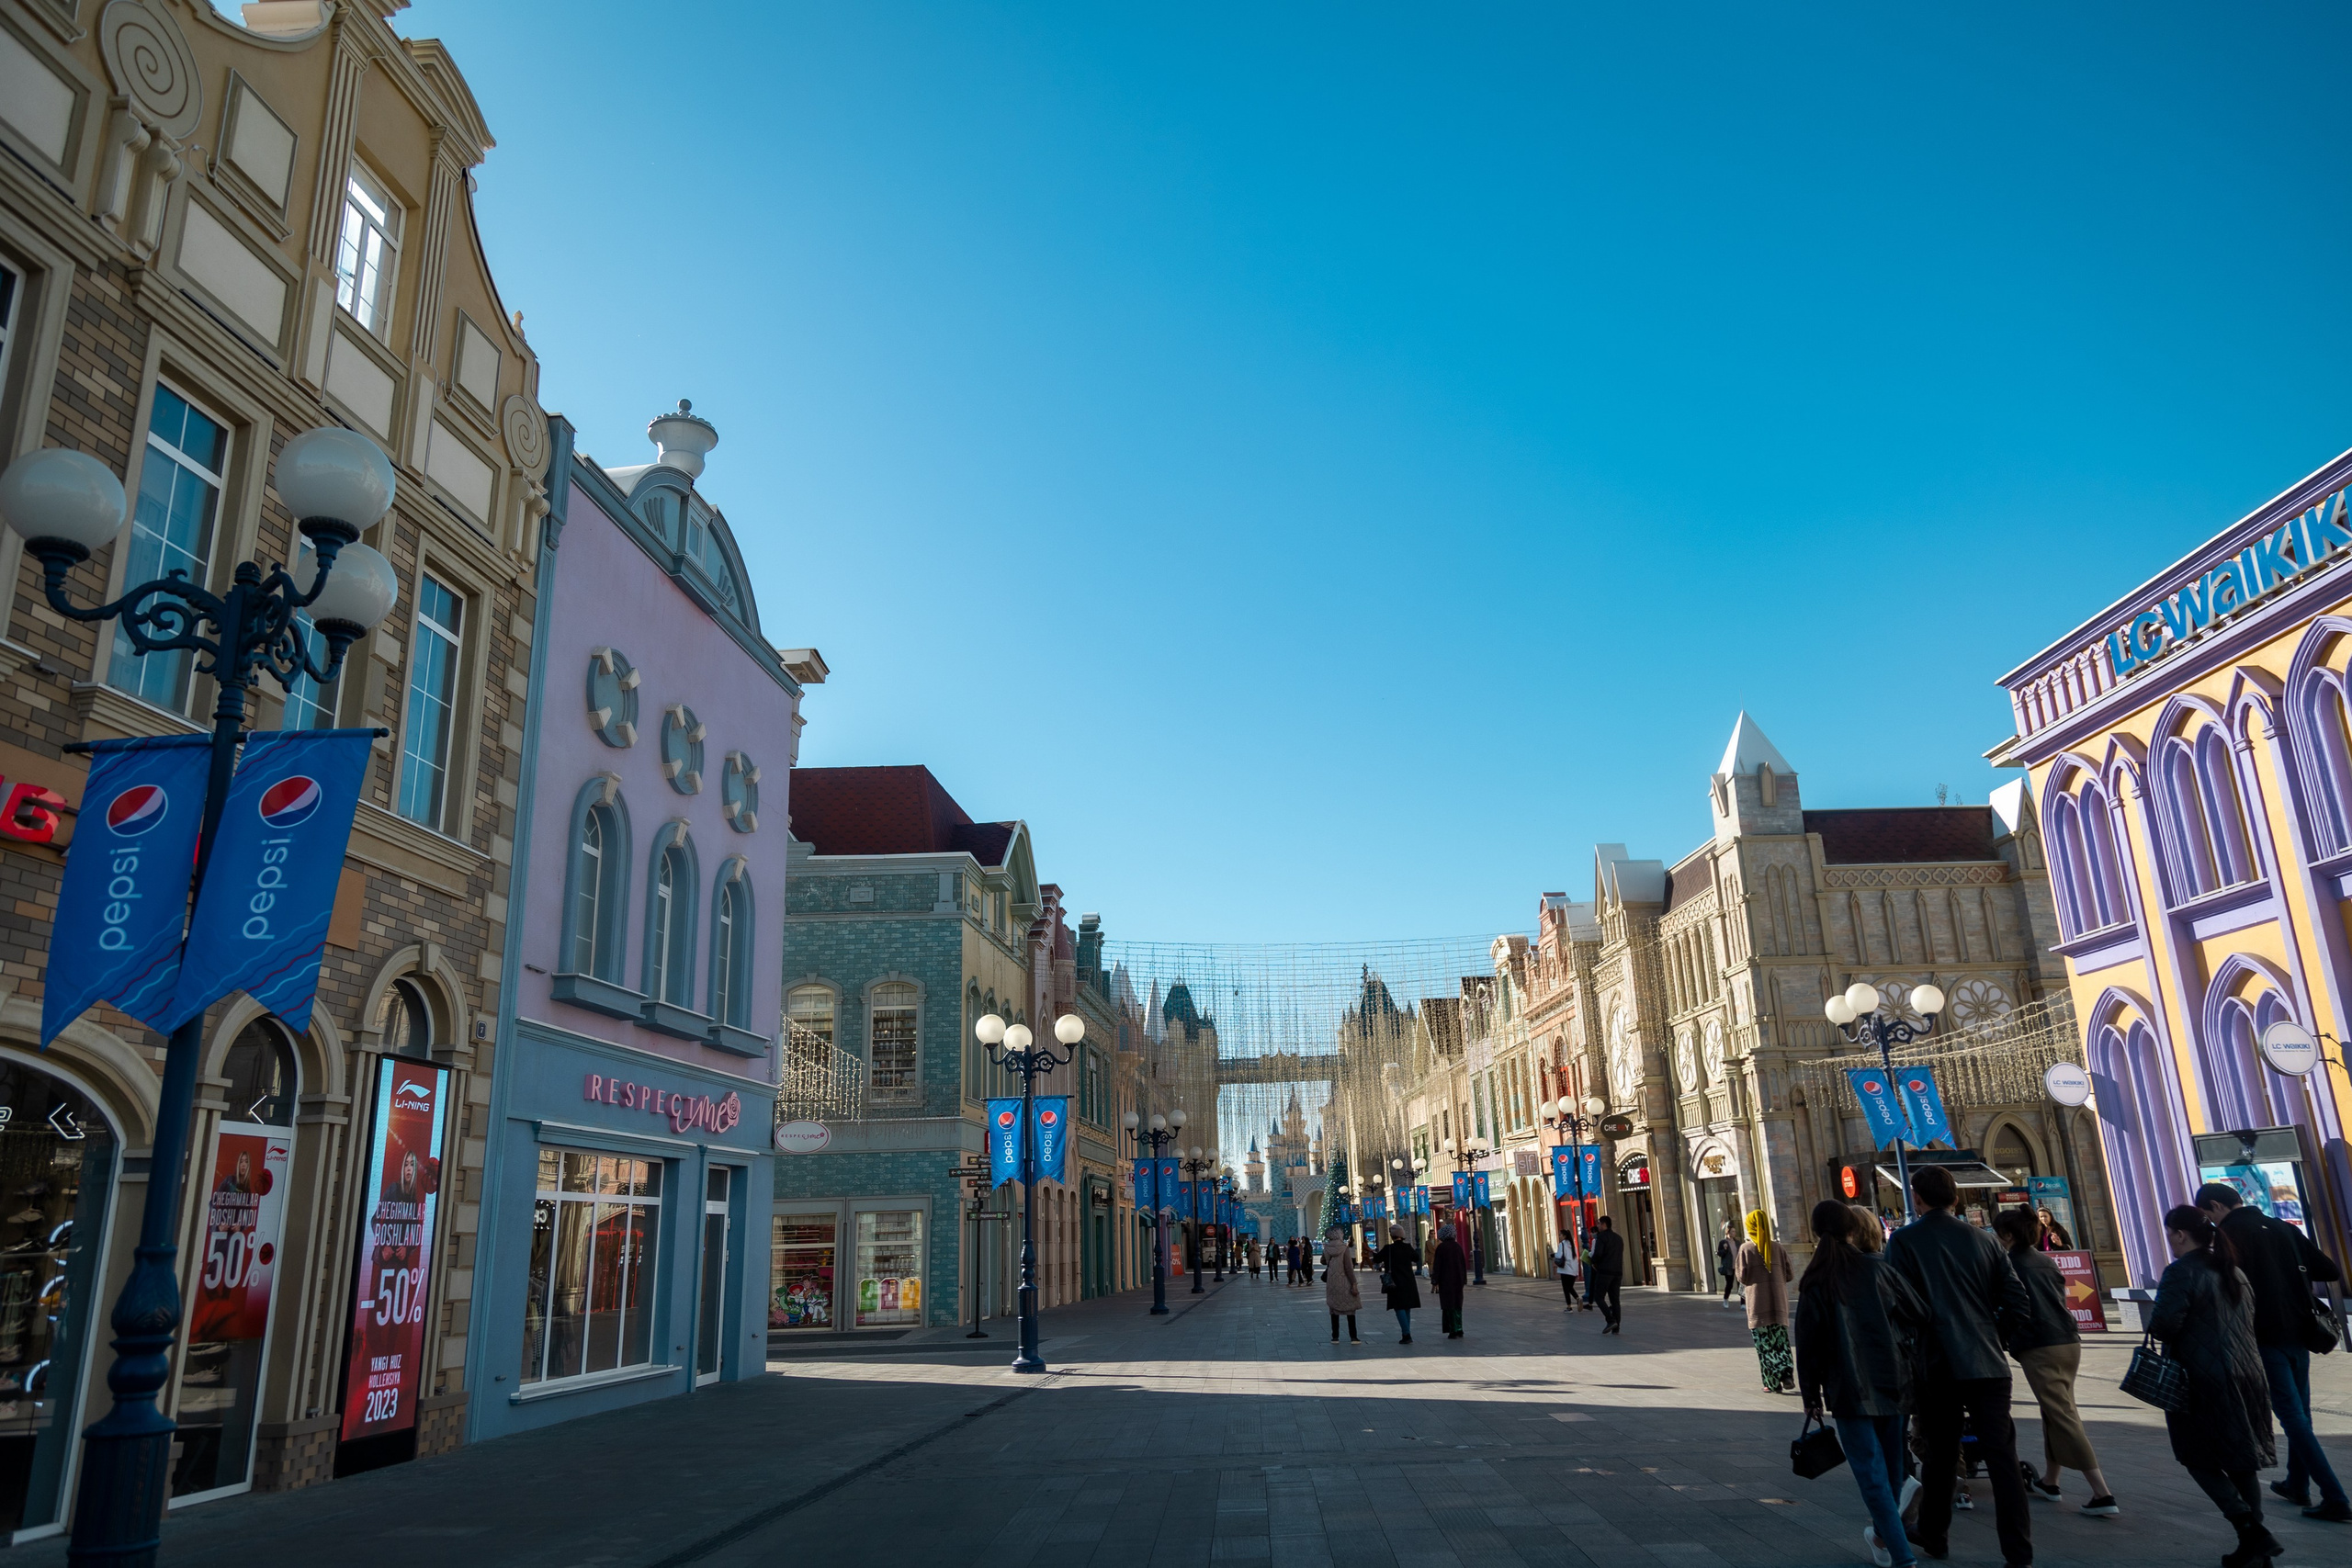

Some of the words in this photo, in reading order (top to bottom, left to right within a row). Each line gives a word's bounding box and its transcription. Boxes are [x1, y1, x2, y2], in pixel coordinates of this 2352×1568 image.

[2108, 611, 2166, 677] LC
[99, 845, 142, 952] pepsi
[243, 838, 289, 942] pepsi
[395, 1099, 430, 1112] LI-NING
[1872, 1097, 1895, 1125] pepsi
[1917, 1095, 1938, 1125] pepsi
[1002, 1132, 1015, 1164] pepsi
[1042, 1131, 1054, 1162] pepsi
[209, 1208, 257, 1226] BOSHLANDI
[374, 1223, 424, 1247] BOSHLANDI
[204, 1231, 265, 1290] 50%
[365, 1388, 399, 1423] 2023
